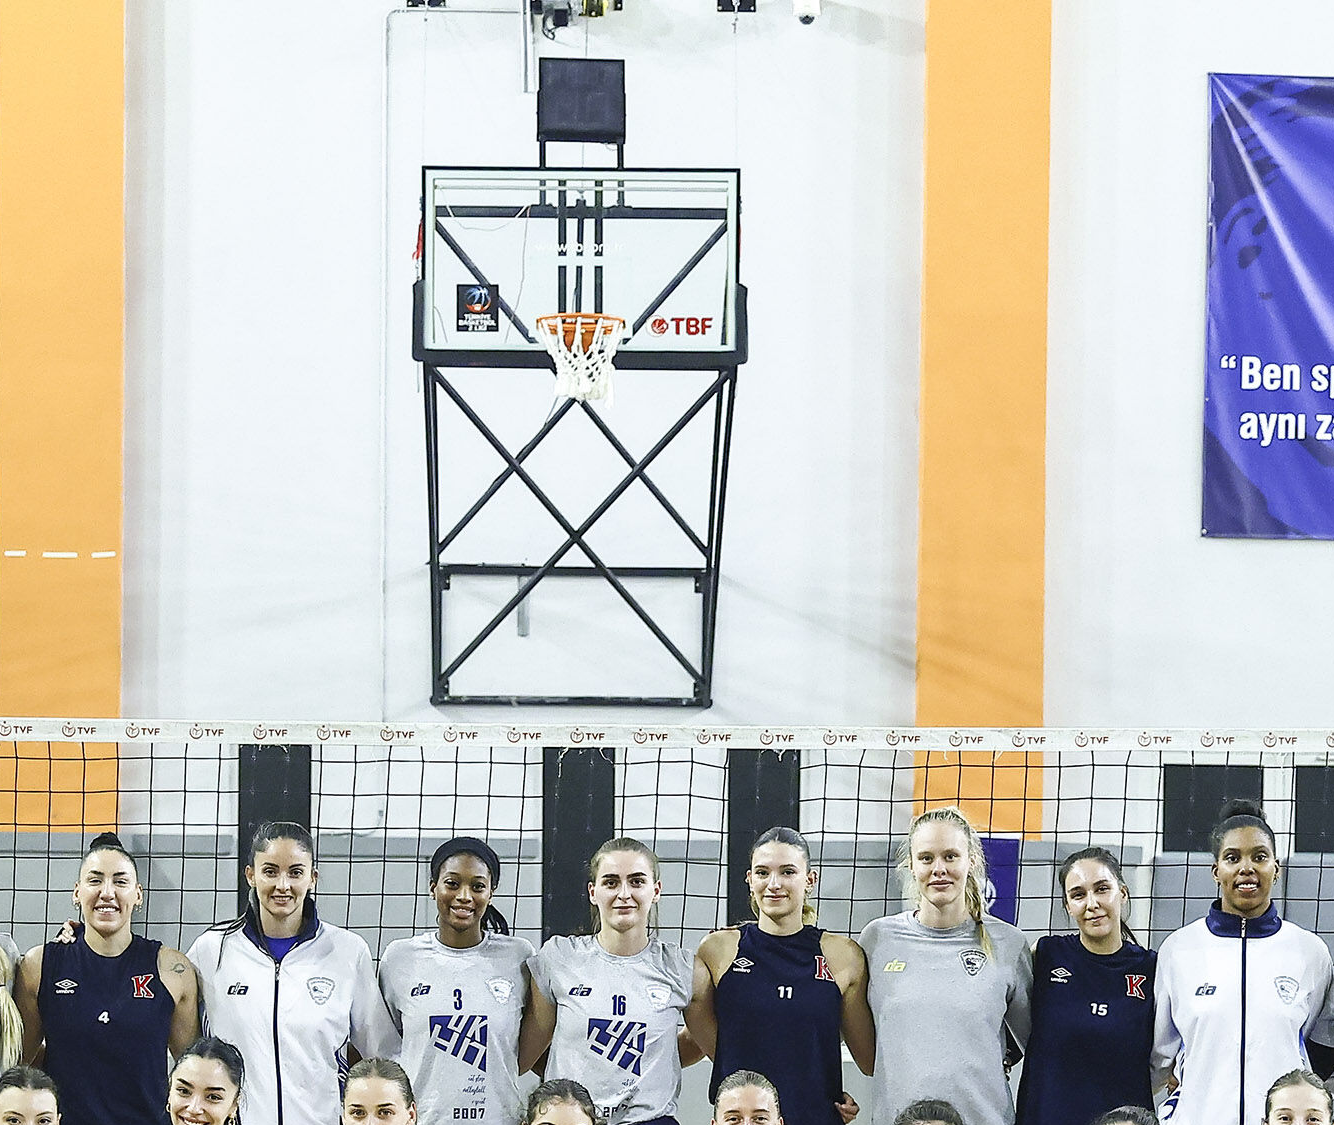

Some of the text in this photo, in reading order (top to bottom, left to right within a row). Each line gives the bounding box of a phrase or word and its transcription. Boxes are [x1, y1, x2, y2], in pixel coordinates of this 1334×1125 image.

[671, 317, 713, 335] TBF
[1239, 412, 1306, 447] aynı
[815, 955, 834, 980] K
[131, 974, 154, 998] K
[777, 986, 793, 999] 11
[1125, 974, 1147, 1000] K
[453, 988, 462, 1010] 3
[612, 995, 626, 1015] 16
[98, 1012, 109, 1023] 4
[1090, 1003, 1108, 1016] 15
[453, 1108, 485, 1119] 2007
